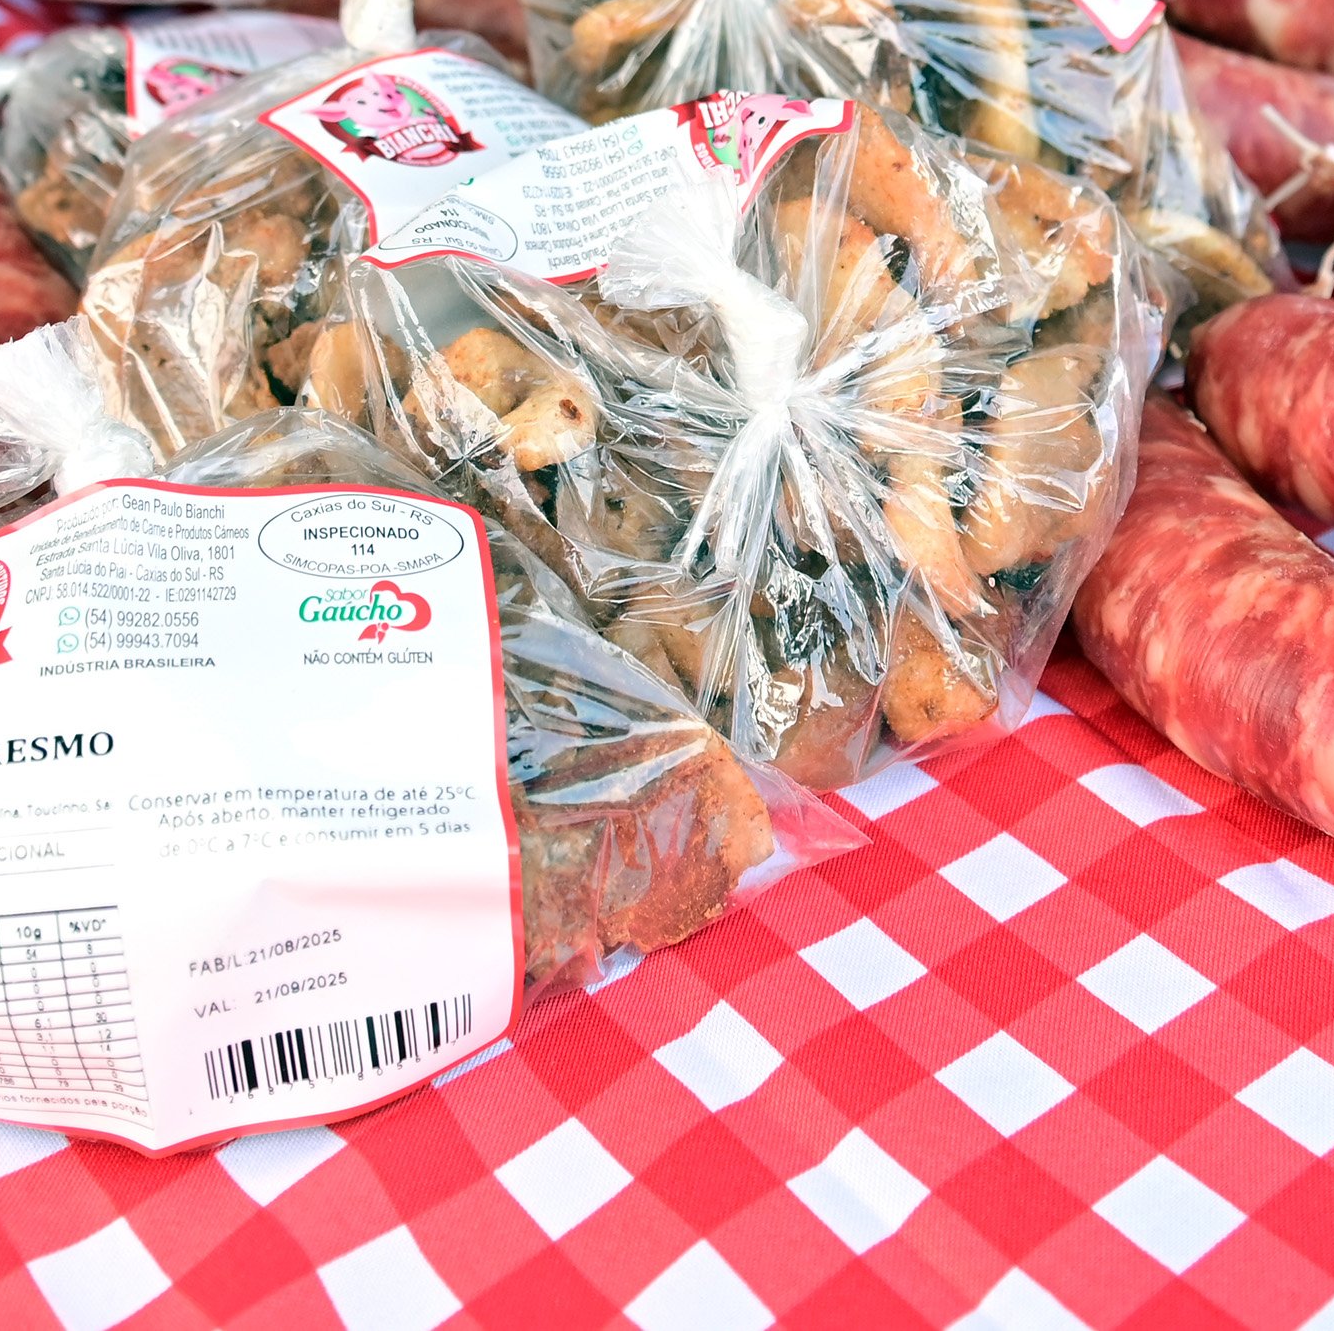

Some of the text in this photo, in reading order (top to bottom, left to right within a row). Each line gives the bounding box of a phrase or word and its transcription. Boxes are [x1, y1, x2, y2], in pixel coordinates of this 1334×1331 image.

[373, 123, 459, 160] BIANCHI
[597, 134, 620, 149] (54)
[604, 149, 625, 166] (54)
[626, 191, 652, 207] Santa
[440, 209, 459, 217] 114
[535, 205, 547, 217] RS
[531, 223, 552, 235] 1801
[412, 237, 433, 245] RS
[548, 246, 607, 271] Paulo Bianchi
[57, 504, 100, 533] Produzido
[122, 494, 150, 513] Gean
[153, 498, 183, 519] Paulo
[186, 502, 225, 519] Bianchi
[290, 499, 433, 526] Caxias do Sul RS
[30, 531, 59, 555] Unidade
[130, 516, 140, 531] de
[142, 519, 165, 538] Carne
[168, 527, 173, 538] e
[176, 523, 212, 540] Produtos
[214, 525, 250, 540] Cárneos
[303, 526, 420, 540] INSPECIONADO
[36, 536, 235, 566] Estrada Santa Lúcia Vila Oliva, 1801
[351, 544, 375, 556] 114
[40, 563, 64, 582] Santa
[67, 561, 92, 576] Lúcia
[94, 563, 106, 577] do
[136, 564, 167, 582] Caxias
[170, 566, 182, 582] do
[185, 566, 200, 582] Sul
[209, 566, 224, 580] RS
[56, 582, 151, 602] 58.014.522/0001-22
[165, 586, 237, 603] IE:0291142729
[324, 587, 368, 602] Sabor
[299, 593, 403, 623] Gaúcho
[85, 608, 199, 630] (54) 99282.0556
[84, 632, 199, 654] (54) 99943.7094
[304, 647, 433, 665] NÃO CONTÉM GLÚTEN
[40, 657, 216, 677] INDÚSTRIA BRASILEIRA
[128, 791, 217, 812] Conservar
[224, 789, 252, 803] em
[258, 787, 369, 804] temperatura
[374, 786, 396, 801] de
[402, 787, 429, 801] até
[159, 812, 205, 829] Após
[281, 804, 344, 818] manter
[350, 803, 450, 820] refrigerado
[279, 834, 288, 846] e
[296, 827, 379, 843] consumir
[385, 823, 413, 838] em
[419, 822, 429, 835] 5
[435, 820, 472, 834] dias
[17, 926, 42, 940] 10g
[26, 949, 37, 960] 54
[194, 971, 348, 1019] VAL: 21/09/2025
